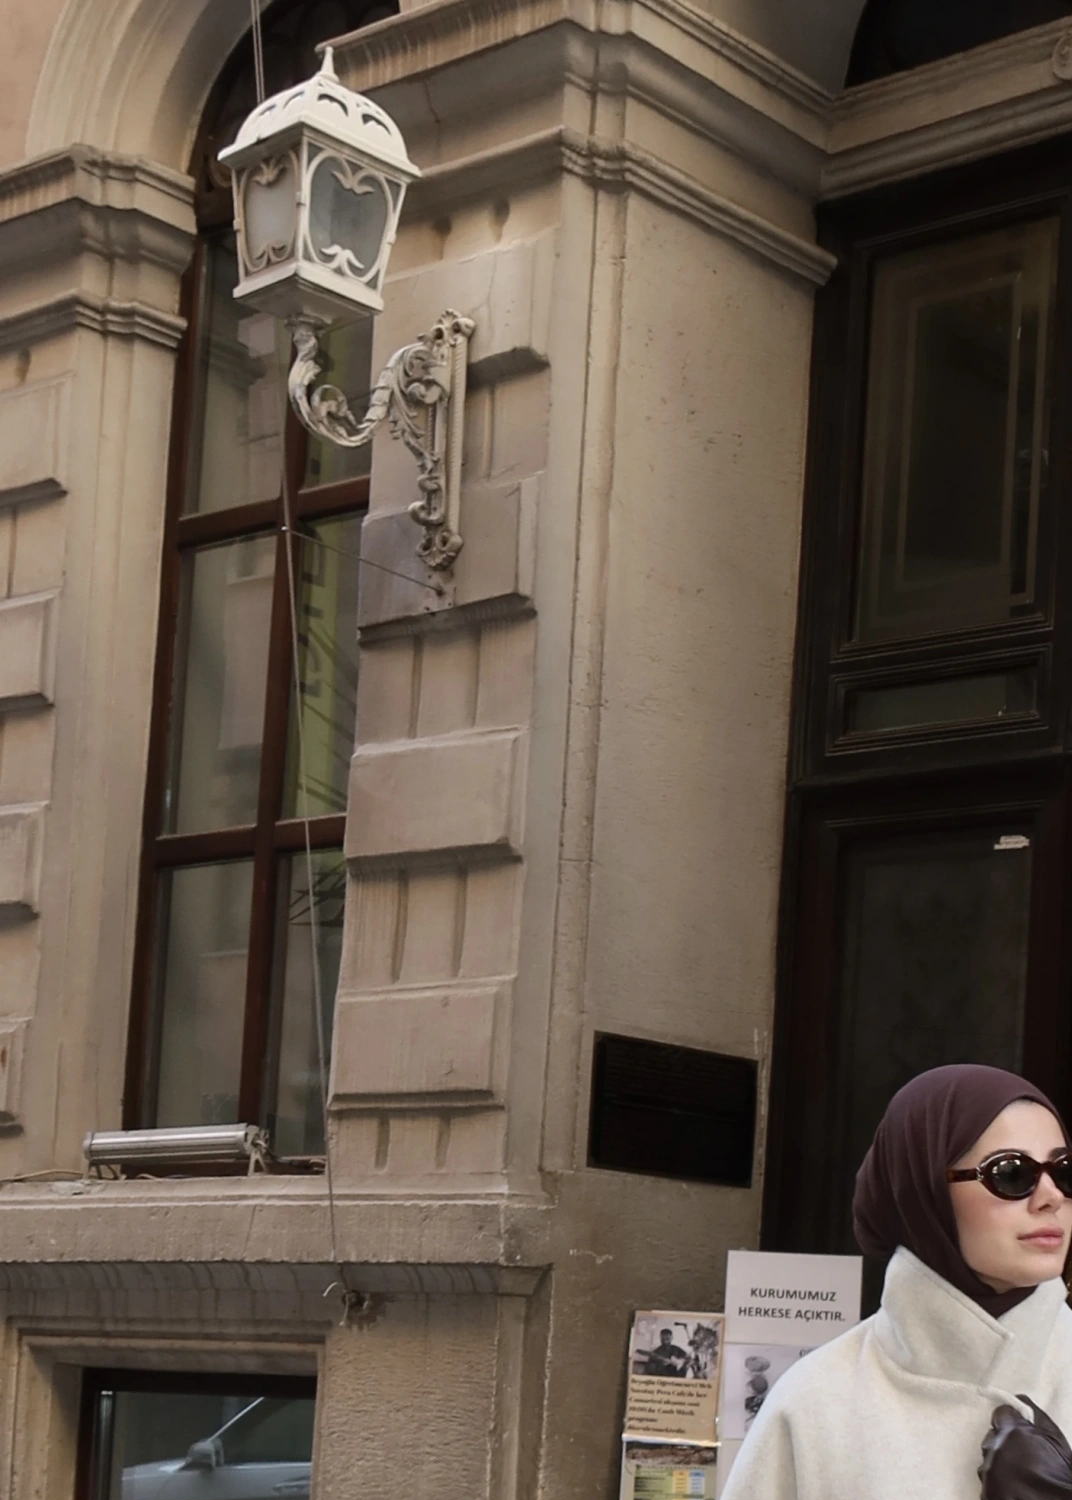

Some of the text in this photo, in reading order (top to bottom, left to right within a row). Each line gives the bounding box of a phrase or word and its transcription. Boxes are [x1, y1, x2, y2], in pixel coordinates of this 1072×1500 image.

[750, 1287, 837, 1302] KURUMUMUZ
[738, 1306, 846, 1323] HERKESE AÇIKTIR.
